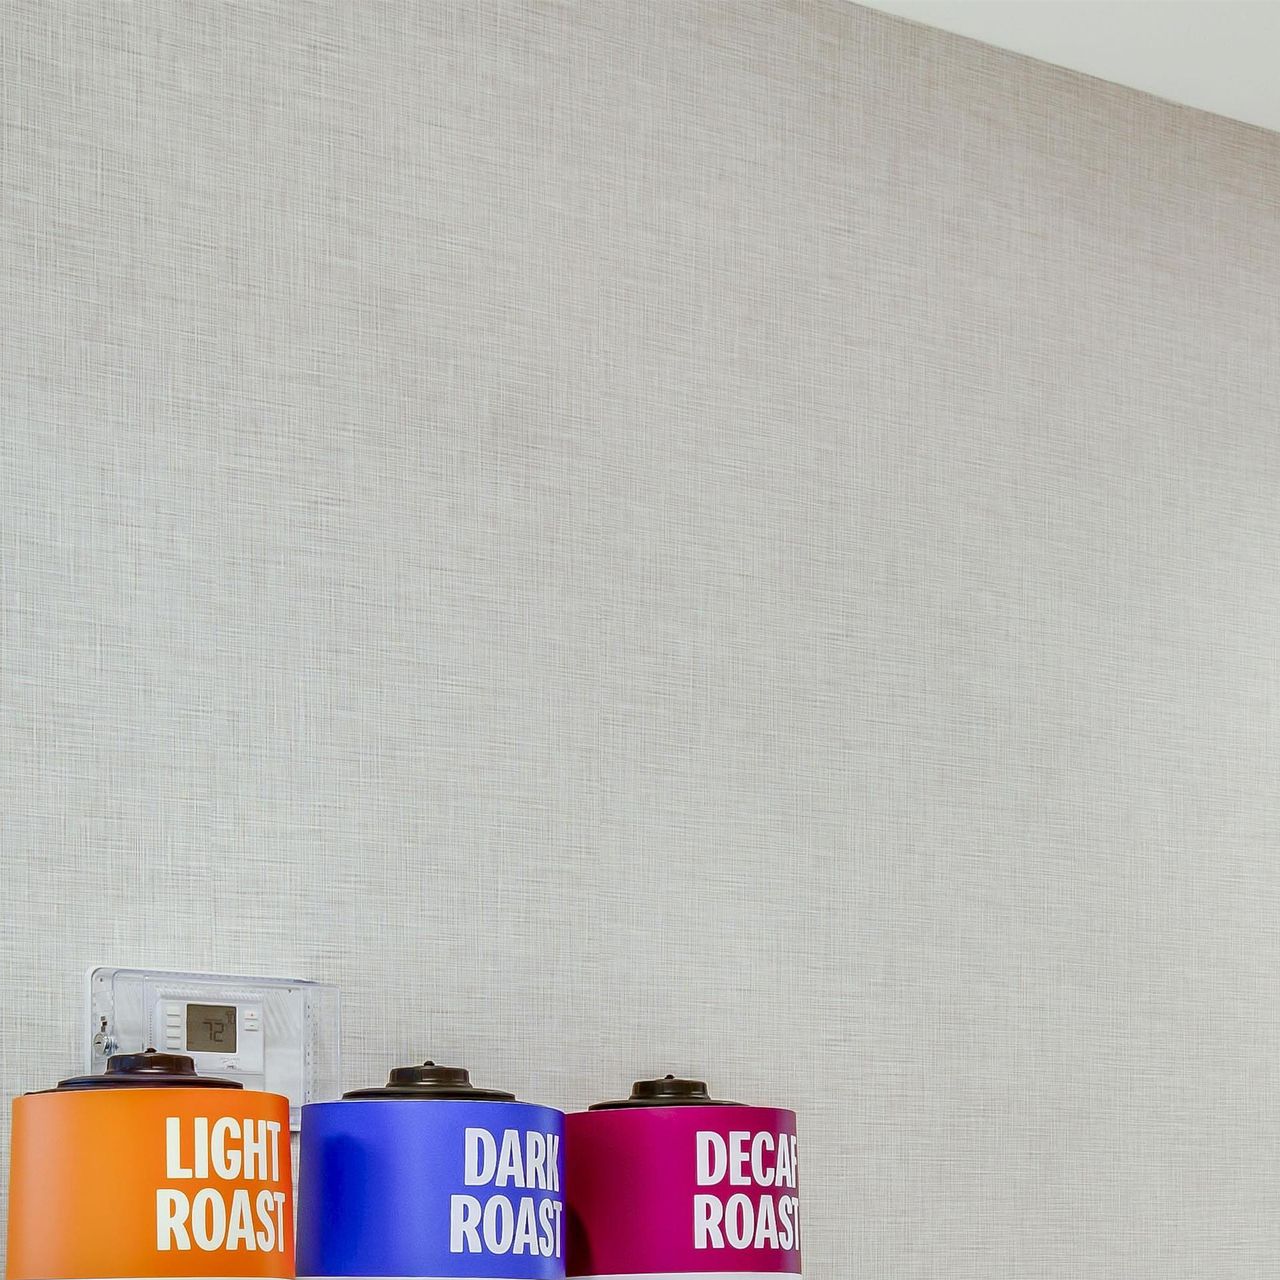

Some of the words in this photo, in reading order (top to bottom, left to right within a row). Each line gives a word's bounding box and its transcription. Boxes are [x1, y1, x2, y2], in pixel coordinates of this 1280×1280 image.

[203, 1021, 225, 1042] 72
[166, 1116, 281, 1182] LIGHT
[464, 1127, 560, 1192] DARK
[695, 1130, 798, 1189] DECAF
[156, 1187, 286, 1253] ROAST
[449, 1194, 563, 1258] ROAST
[693, 1193, 800, 1251] ROAST
